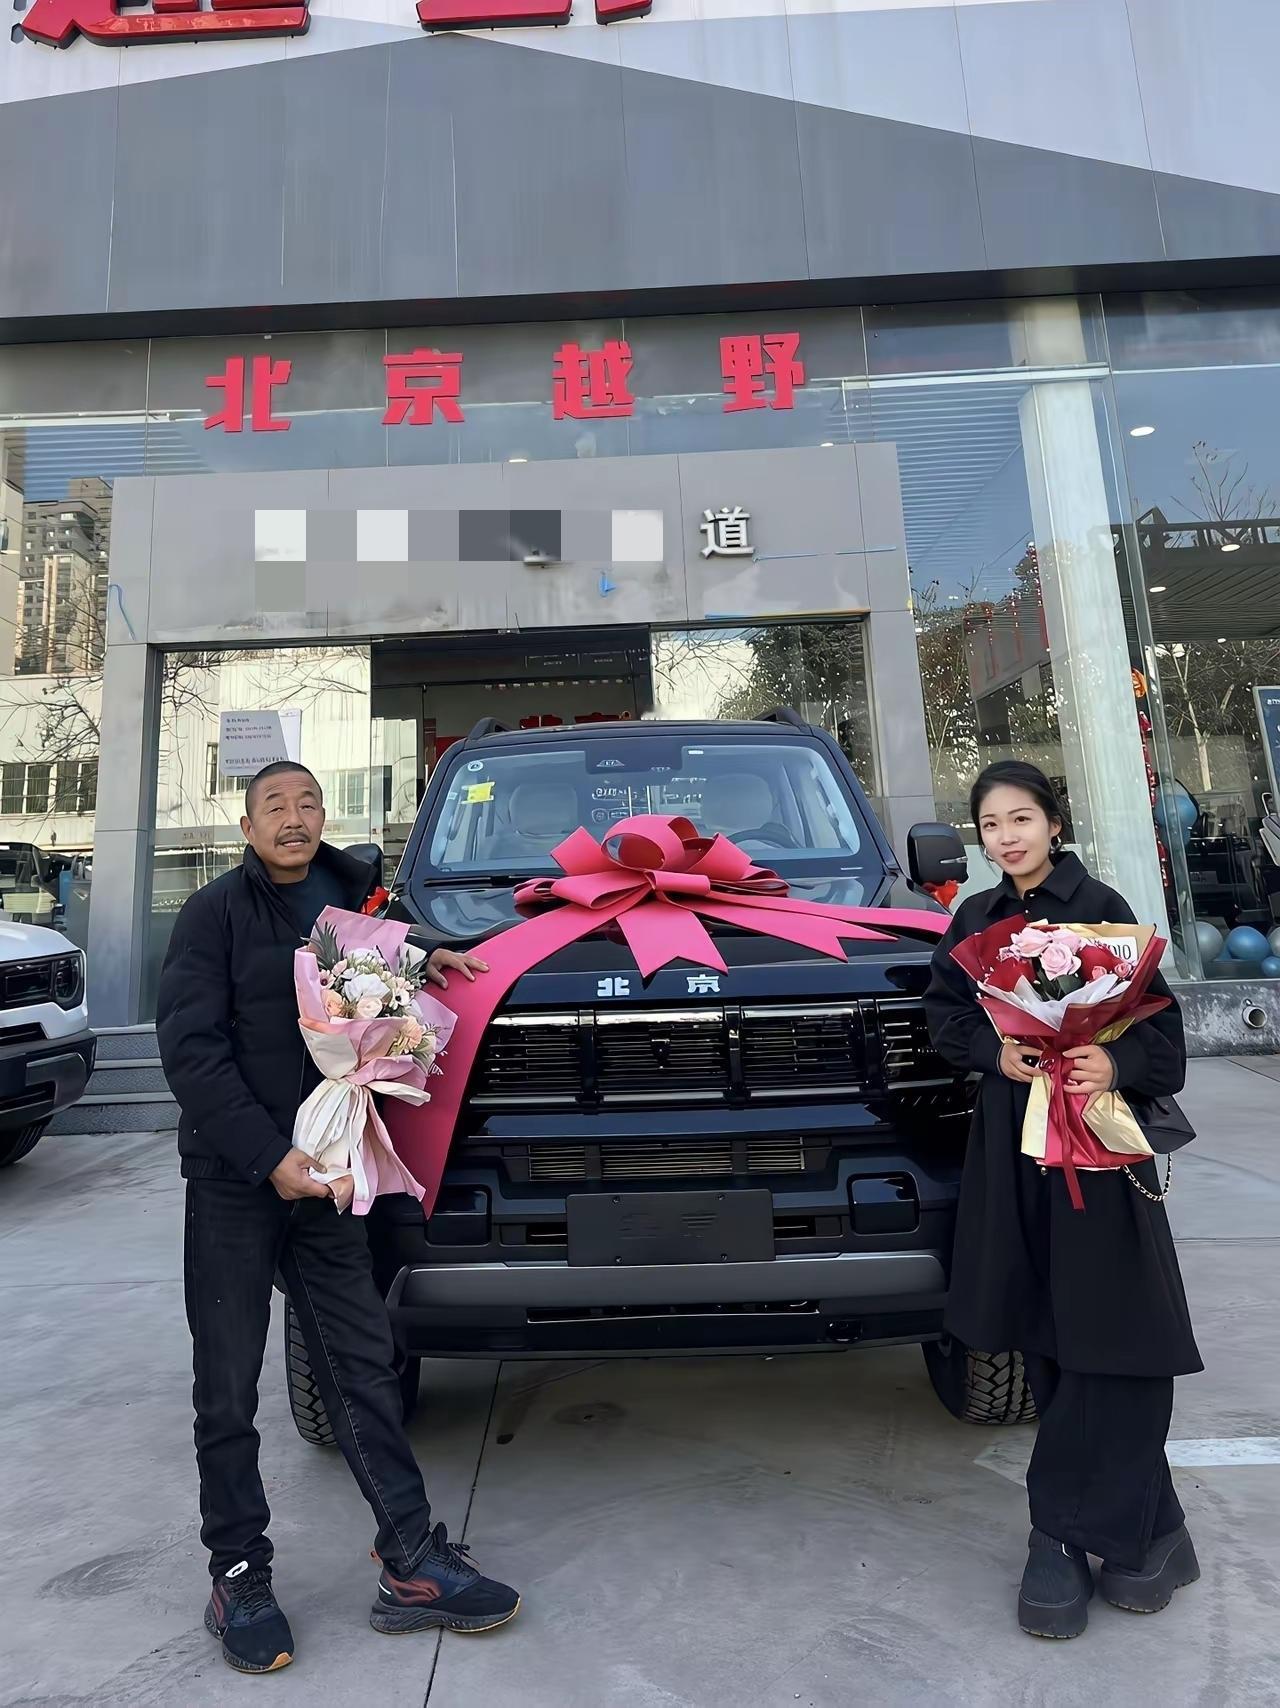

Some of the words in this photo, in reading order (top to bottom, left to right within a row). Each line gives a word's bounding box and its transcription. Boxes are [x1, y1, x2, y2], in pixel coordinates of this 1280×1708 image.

[205, 333, 804, 432] 北京越野
[699, 505, 754, 559] 道
[597, 973, 721, 997] 北京
